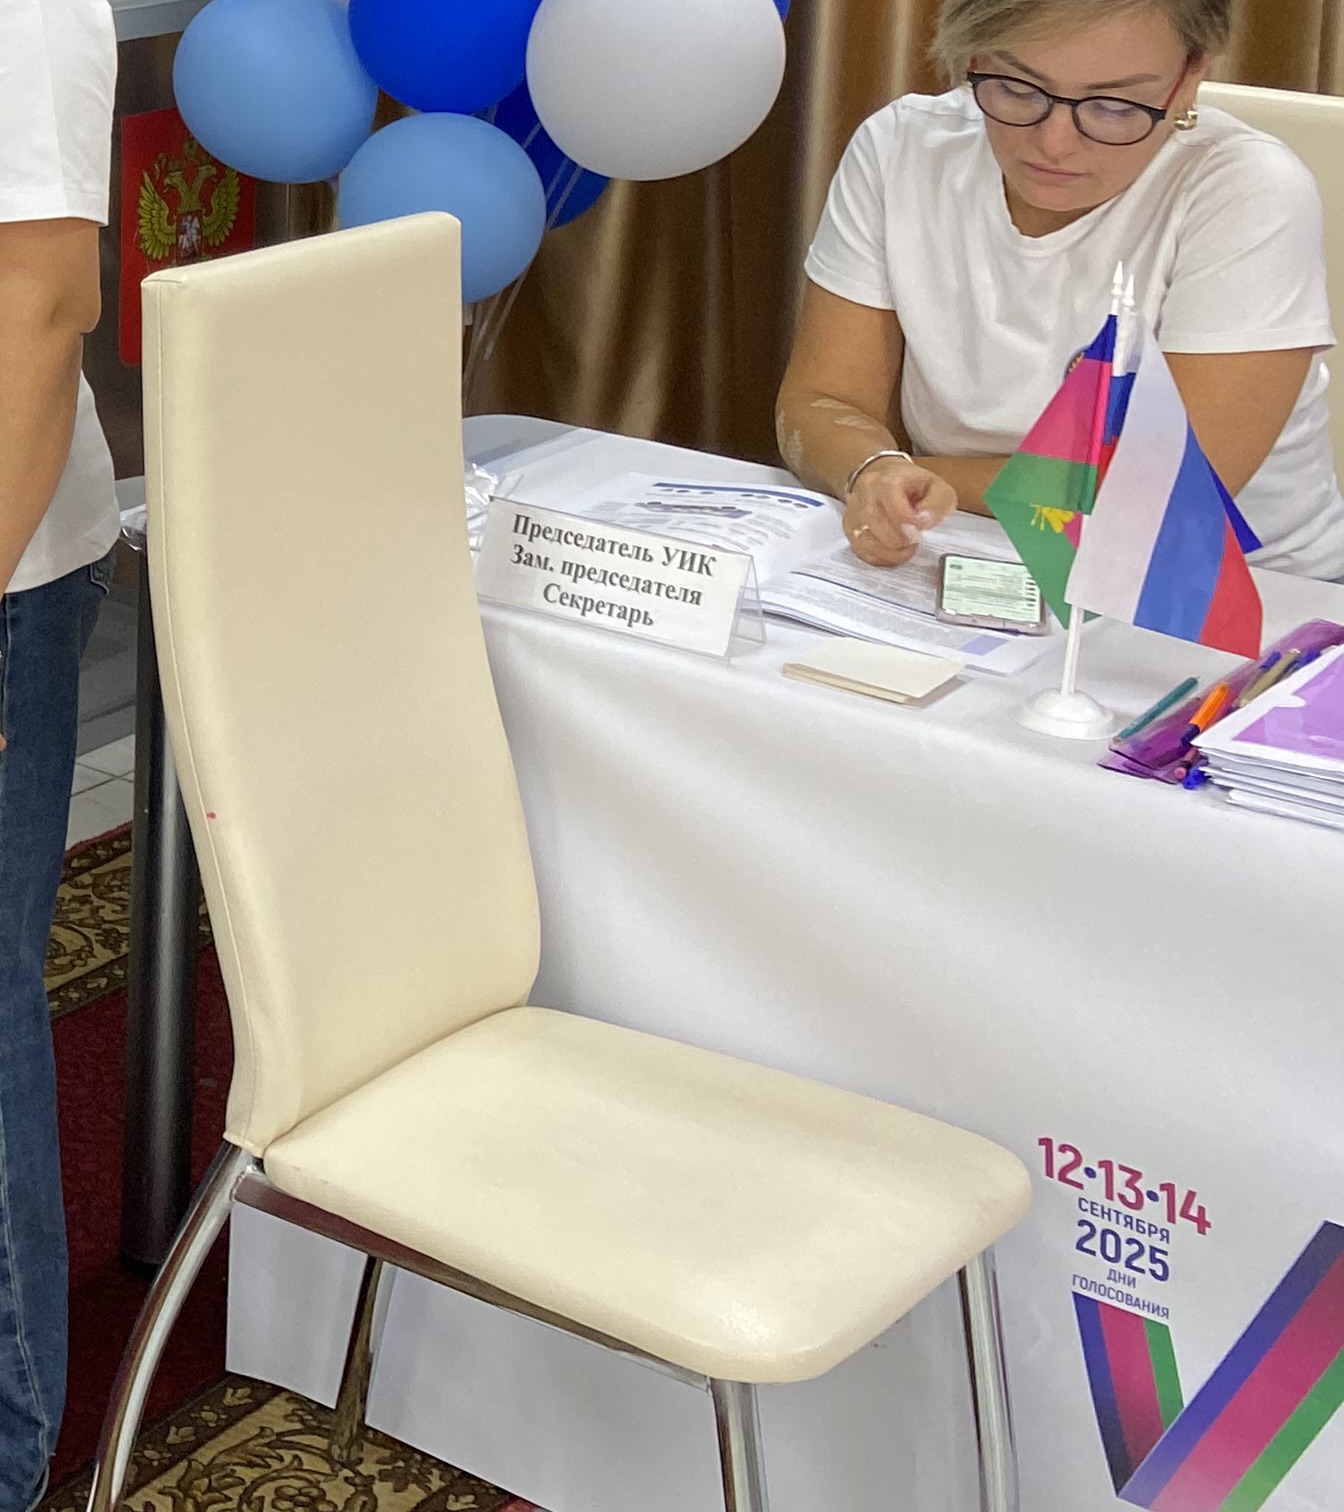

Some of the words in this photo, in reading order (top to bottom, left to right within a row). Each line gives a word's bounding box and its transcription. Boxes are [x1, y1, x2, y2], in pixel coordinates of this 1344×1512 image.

[512, 513, 654, 563] Председатель
[661, 546, 717, 577] УИК
[510, 544, 554, 572] Зам.
[560, 560, 703, 607] председателя
[542, 582, 655, 627] Секретарь
[1077, 1197, 1170, 1245] СЕНТЯБРЯ
[1075, 1218, 1170, 1283] 2025
[1072, 1273, 1170, 1320] ГОЛОСОВАНИЯ
[1106, 1267, 1137, 1289] ДНИ
